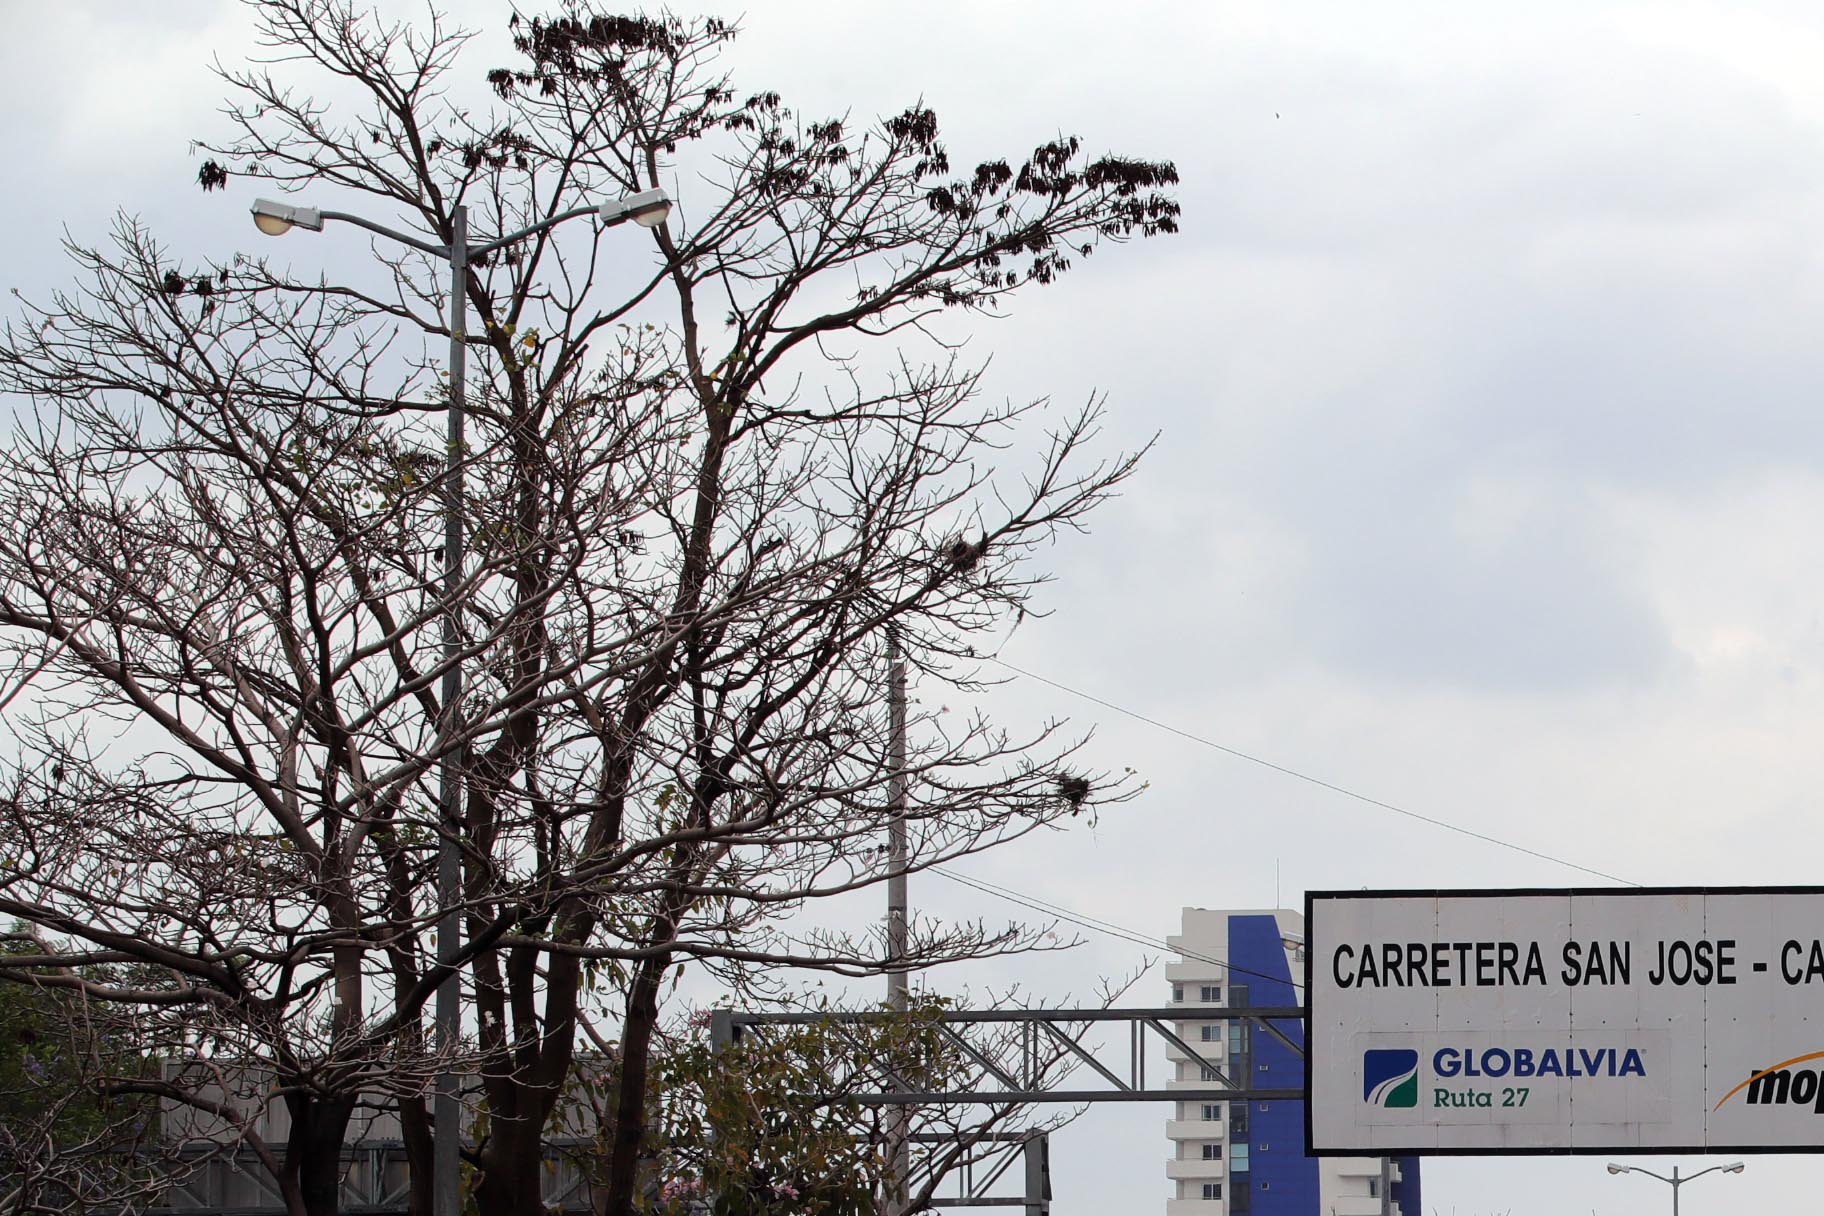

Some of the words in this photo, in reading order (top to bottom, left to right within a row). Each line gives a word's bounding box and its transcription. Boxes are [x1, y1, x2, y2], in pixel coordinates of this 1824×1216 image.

[1331, 941, 1547, 989] CARRETERA
[1561, 940, 1630, 987] SAN
[1648, 939, 1737, 986] JOSE
[1432, 1047, 1646, 1078] GLOBALVIA
[1433, 1088, 1492, 1108] Ruta
[1502, 1087, 1530, 1108] 27
